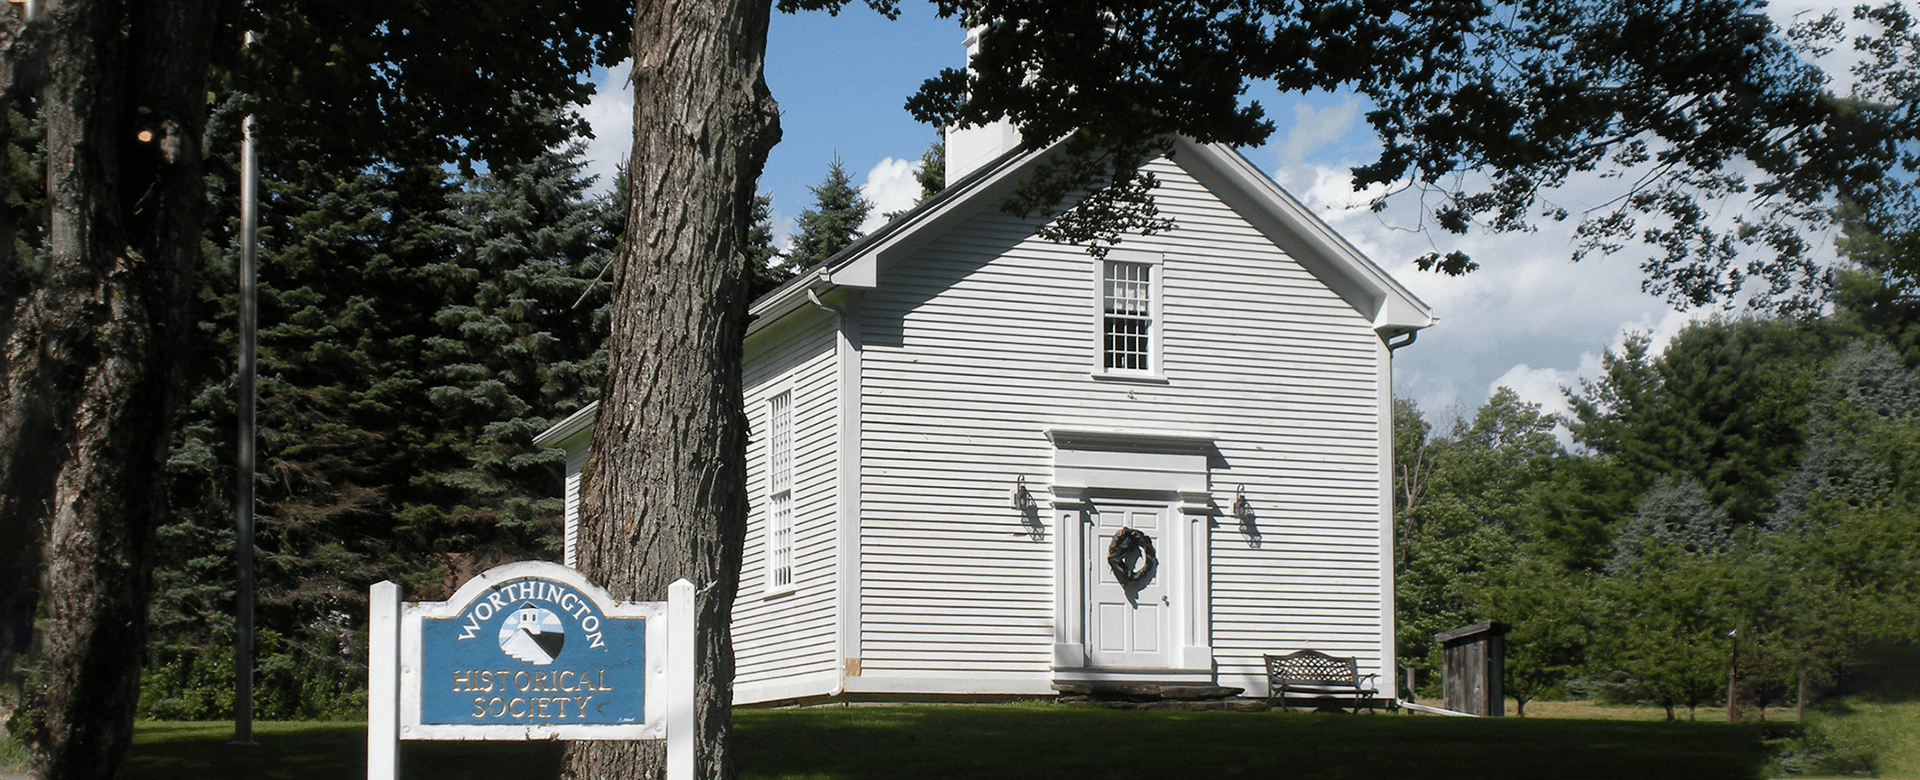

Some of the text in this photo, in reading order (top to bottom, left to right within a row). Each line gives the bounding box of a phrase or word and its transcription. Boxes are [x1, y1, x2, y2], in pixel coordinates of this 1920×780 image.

[458, 581, 605, 650] WORTHINGTON
[452, 669, 613, 693] HISTORICAL
[472, 695, 593, 718] SOCIETY
